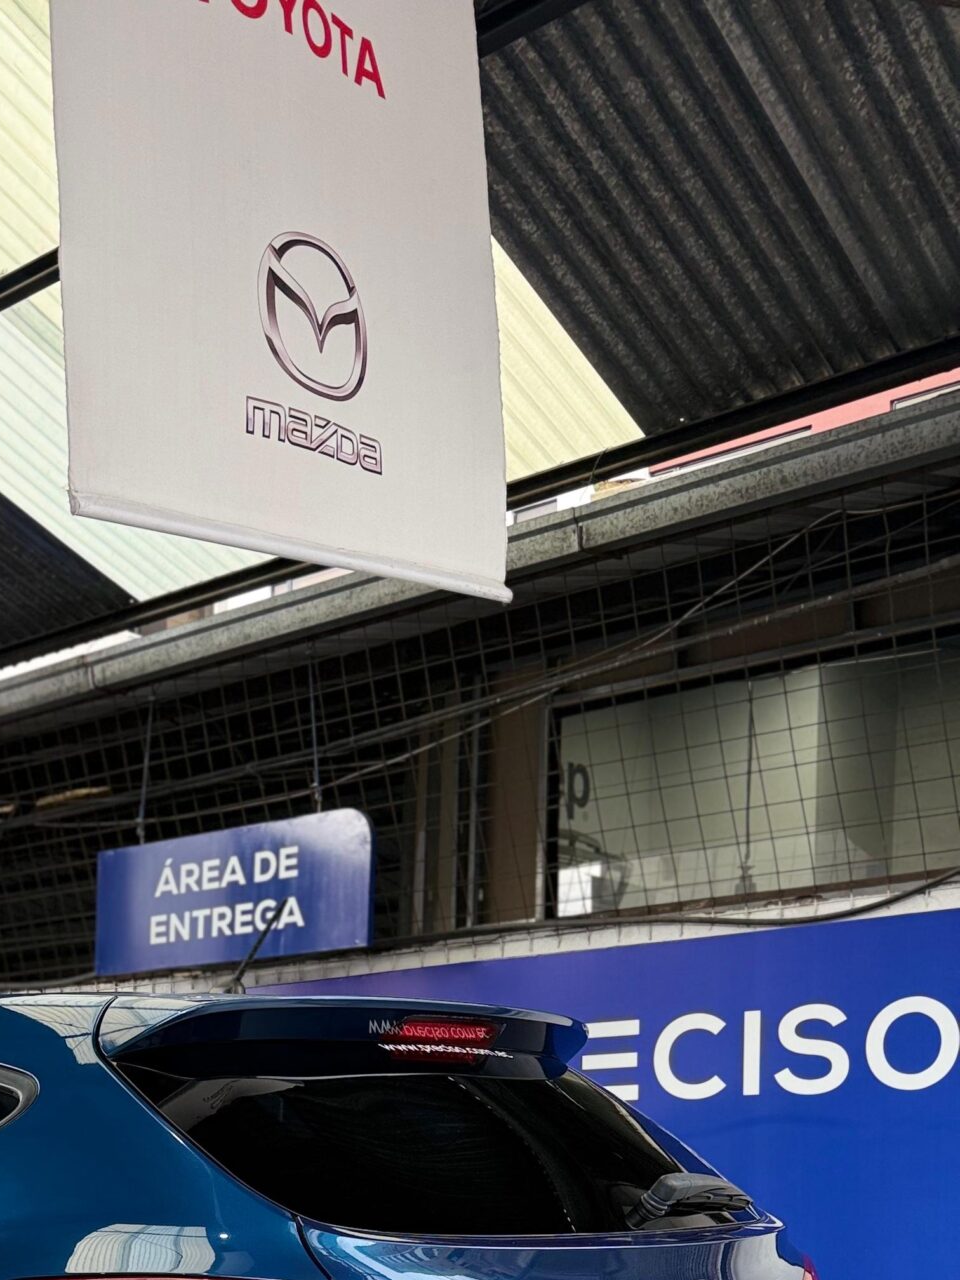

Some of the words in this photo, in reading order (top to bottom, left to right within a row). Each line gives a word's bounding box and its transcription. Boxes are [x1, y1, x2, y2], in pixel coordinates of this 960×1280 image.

[199, 0, 386, 100] YOTA
[154, 856, 247, 898] ÁREA
[253, 845, 300, 884] DE
[149, 896, 306, 946] ENTREGA
[582, 996, 960, 1101] ECISO
